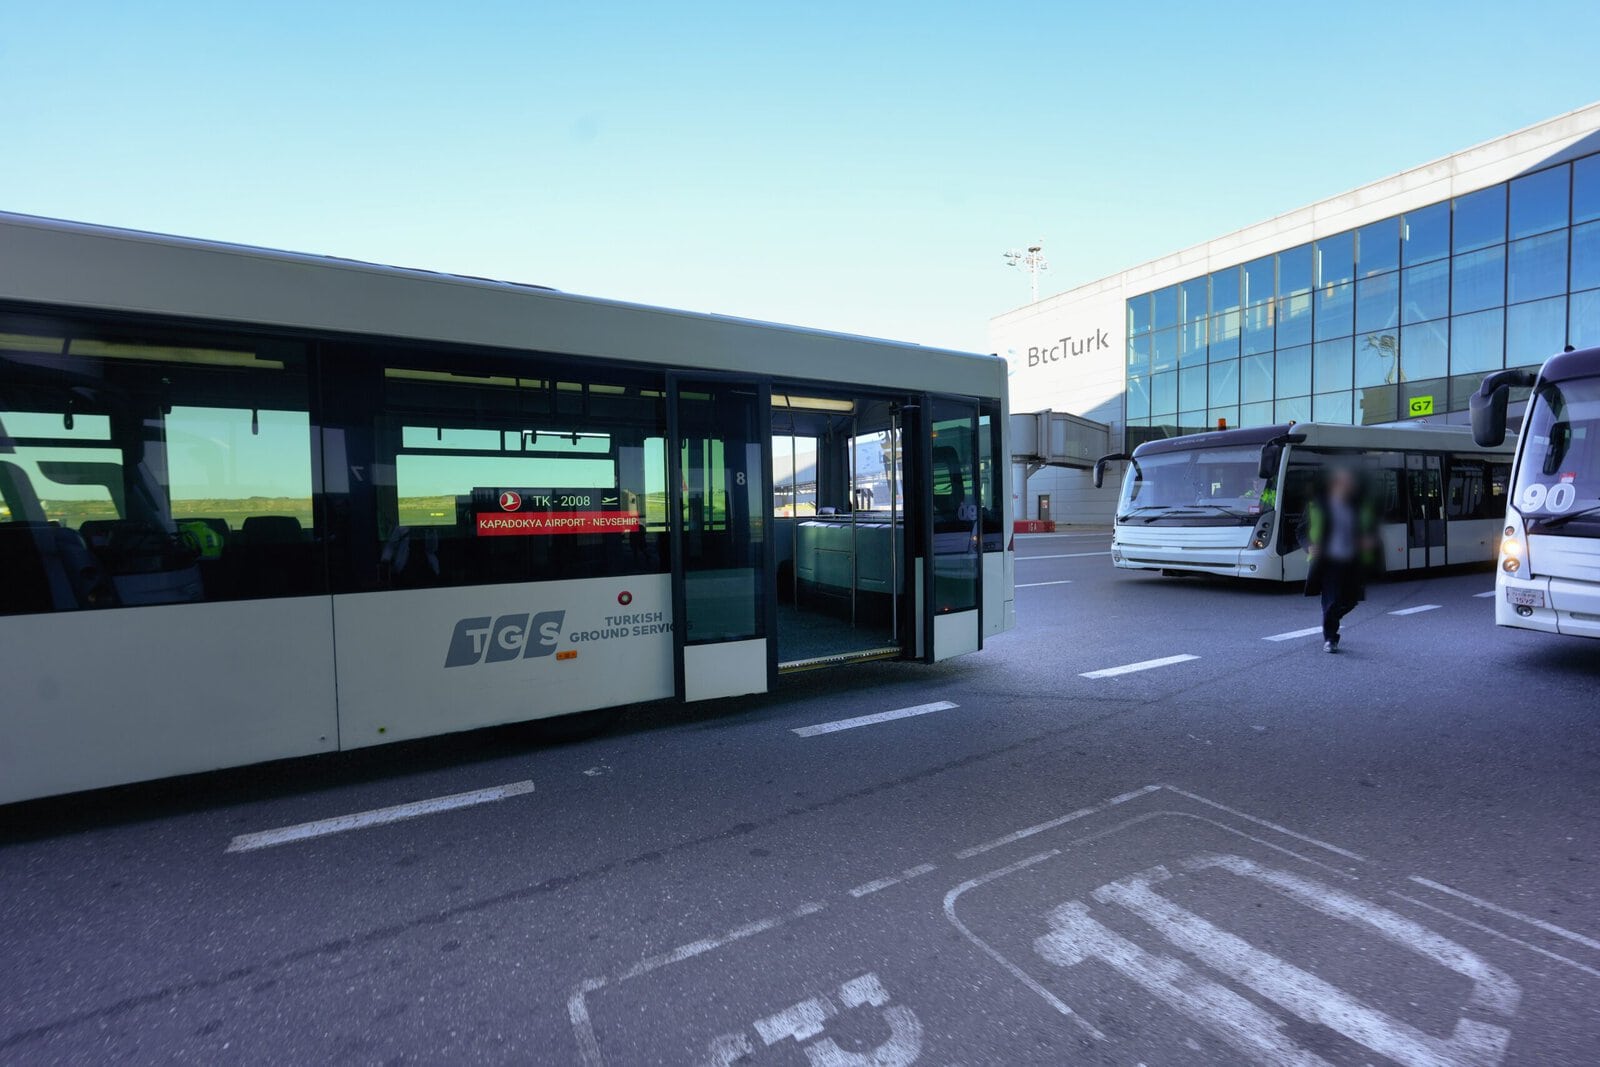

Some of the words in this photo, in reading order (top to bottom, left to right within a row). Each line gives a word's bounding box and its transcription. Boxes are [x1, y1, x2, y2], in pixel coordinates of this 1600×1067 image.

[1028, 328, 1109, 367] BtcTurk
[1411, 400, 1431, 412] G7
[736, 472, 746, 485] 8
[533, 495, 550, 507] TK
[560, 495, 591, 507] 2008
[1521, 482, 1576, 513] 90
[480, 518, 542, 529] KAPADOKYA
[544, 517, 585, 528] AIRPORT
[592, 516, 638, 527] NEVSEHIR
[605, 612, 663, 627] TURKISH
[570, 625, 629, 643] GROUND
